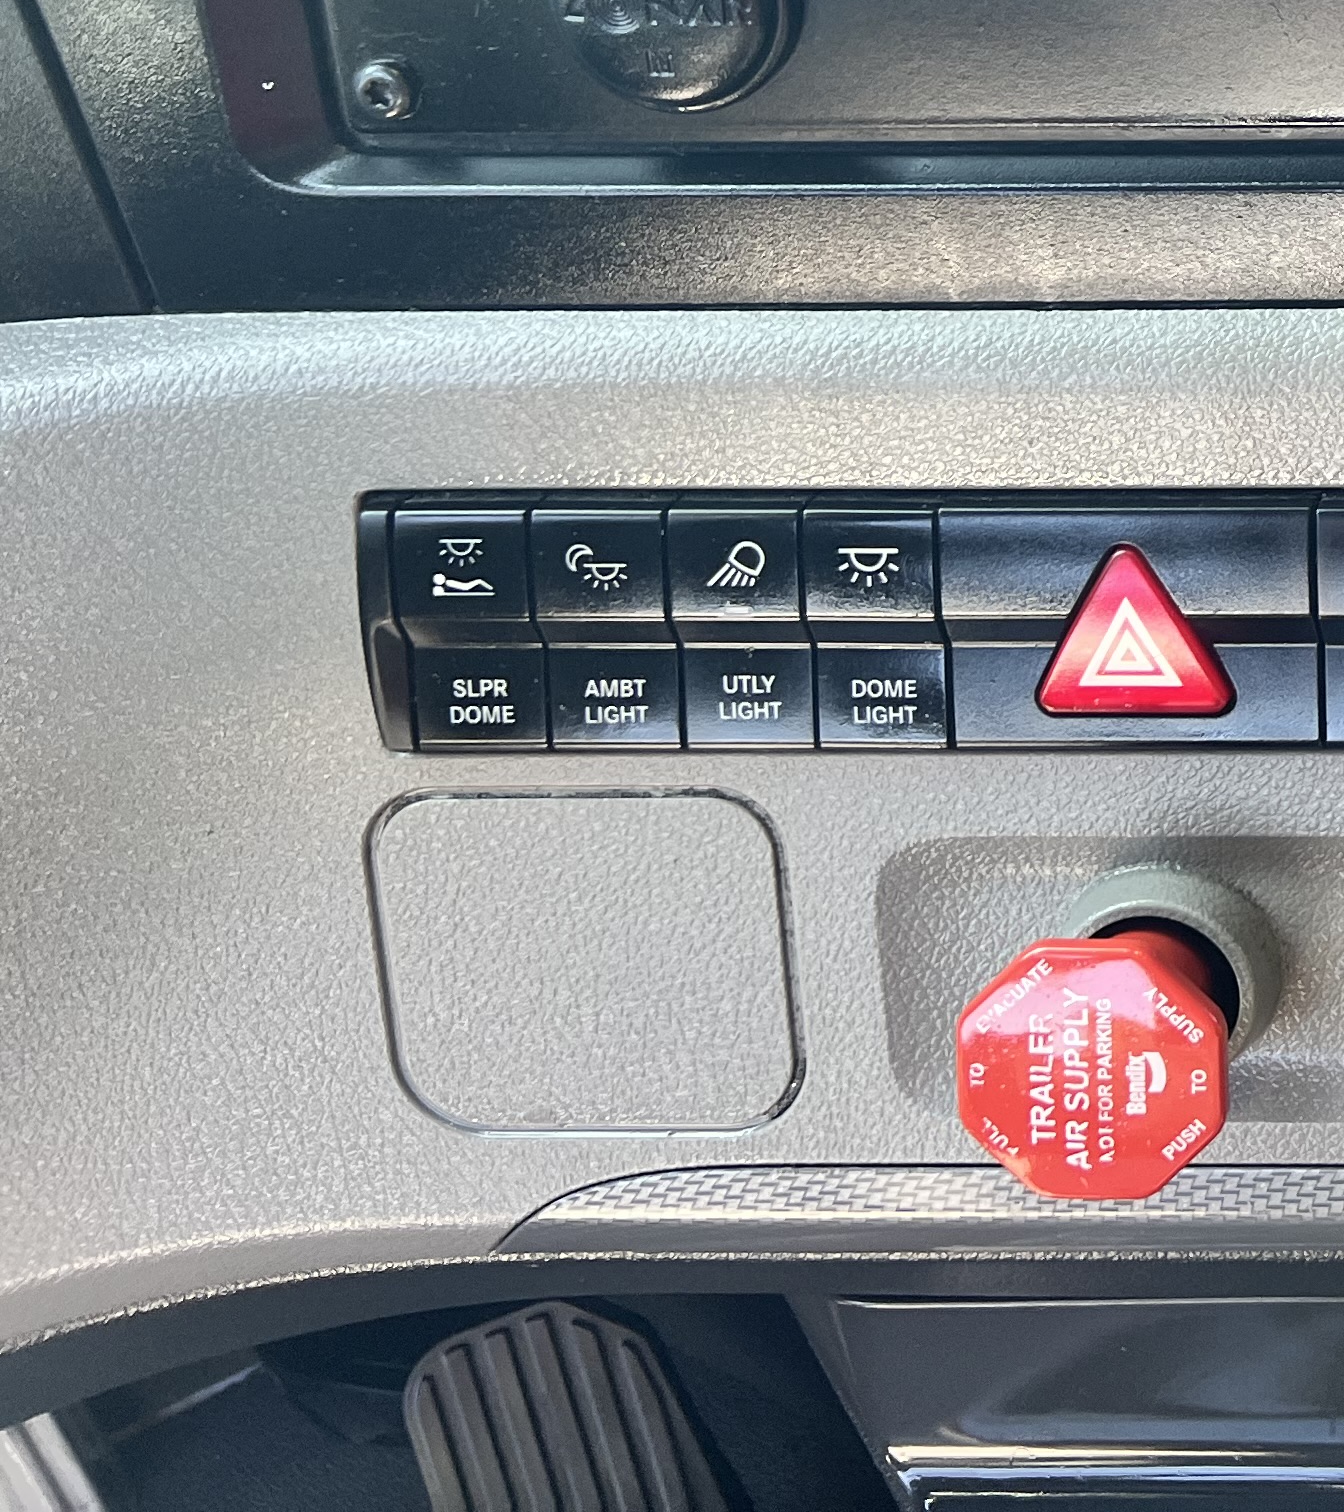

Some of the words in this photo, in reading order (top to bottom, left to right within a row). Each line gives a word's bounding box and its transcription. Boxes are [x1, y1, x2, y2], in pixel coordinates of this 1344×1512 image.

[453, 679, 508, 698] SLPR
[584, 680, 647, 698] AMBT
[722, 675, 776, 695] UTLY
[851, 679, 918, 699] DOME
[450, 705, 515, 725] DOME
[585, 705, 649, 725] LIGHT
[719, 702, 782, 720] LIGHT
[853, 705, 918, 725] LIGHT
[1144, 986, 1204, 1044] SUPPLY
[1063, 987, 1089, 1111] SUPPLY
[1096, 998, 1113, 1082] PARKING
[969, 1062, 985, 1087] TO
[1029, 1013, 1057, 1144] TRAILER
[1125, 1052, 1146, 1116] Bendix
[1191, 1069, 1208, 1095] TO
[1097, 1084, 1114, 1121] FOR
[1066, 1119, 1093, 1170] AIR
[1161, 1118, 1207, 1162] PUSH
